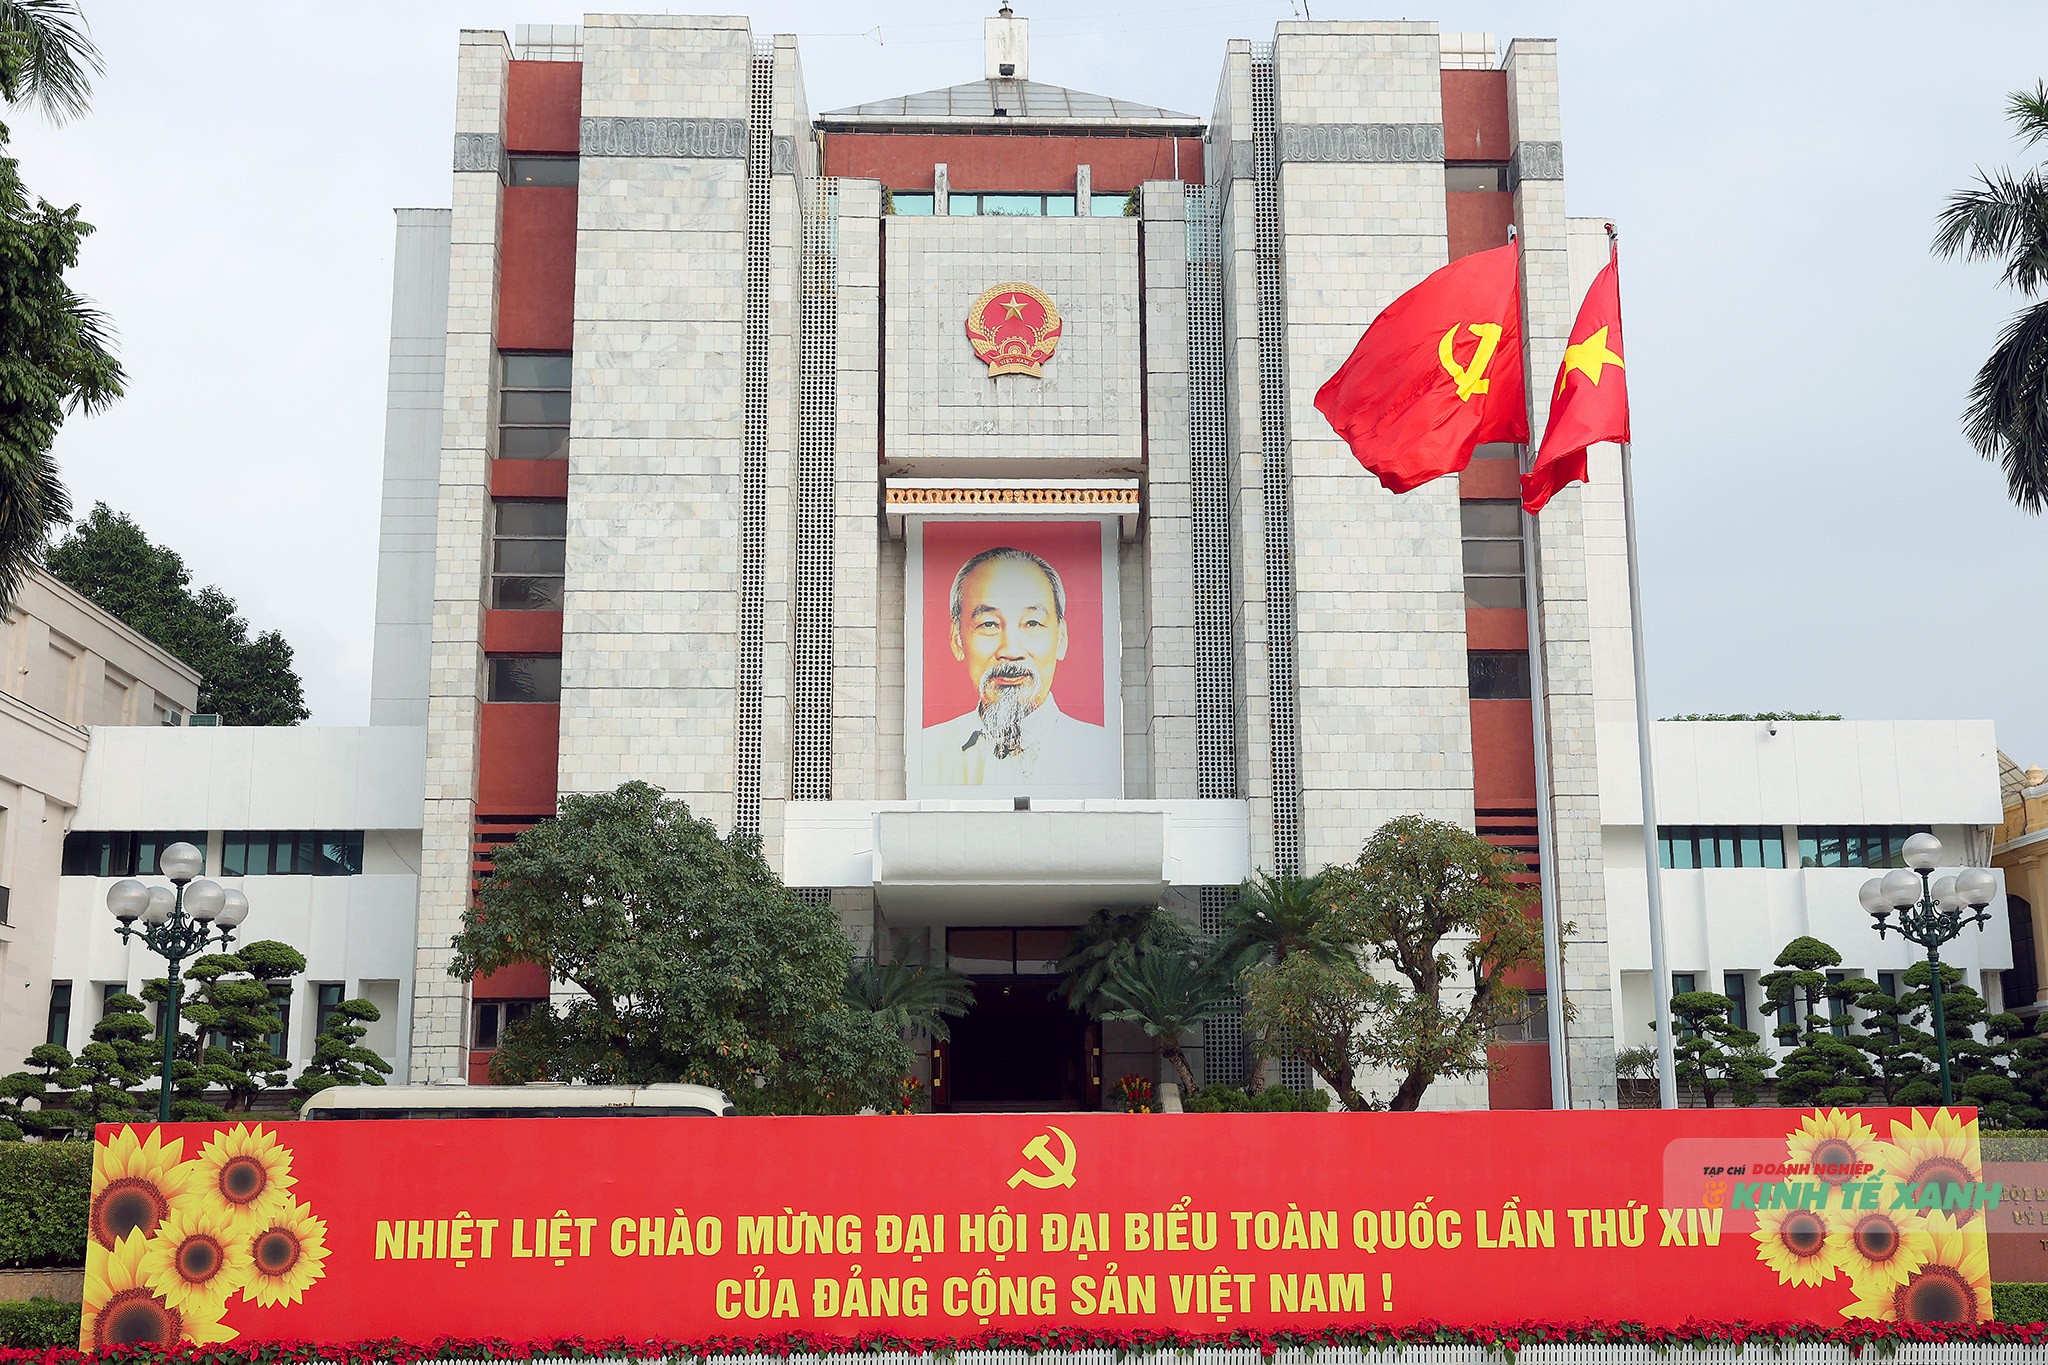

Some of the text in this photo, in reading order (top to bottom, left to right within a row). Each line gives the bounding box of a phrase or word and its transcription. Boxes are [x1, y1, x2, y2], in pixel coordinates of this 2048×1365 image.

[375, 1195, 1724, 1268] NHIỆT LIỆT CHÀO MỪNG ĐẠI HỘI ĐẠI BIỂU TOÀN QUỐC LẦN THỨ XIV
[715, 1261, 1393, 1325] CỦA ĐẢNG CỘNG SẢN VIỆT NAM !
